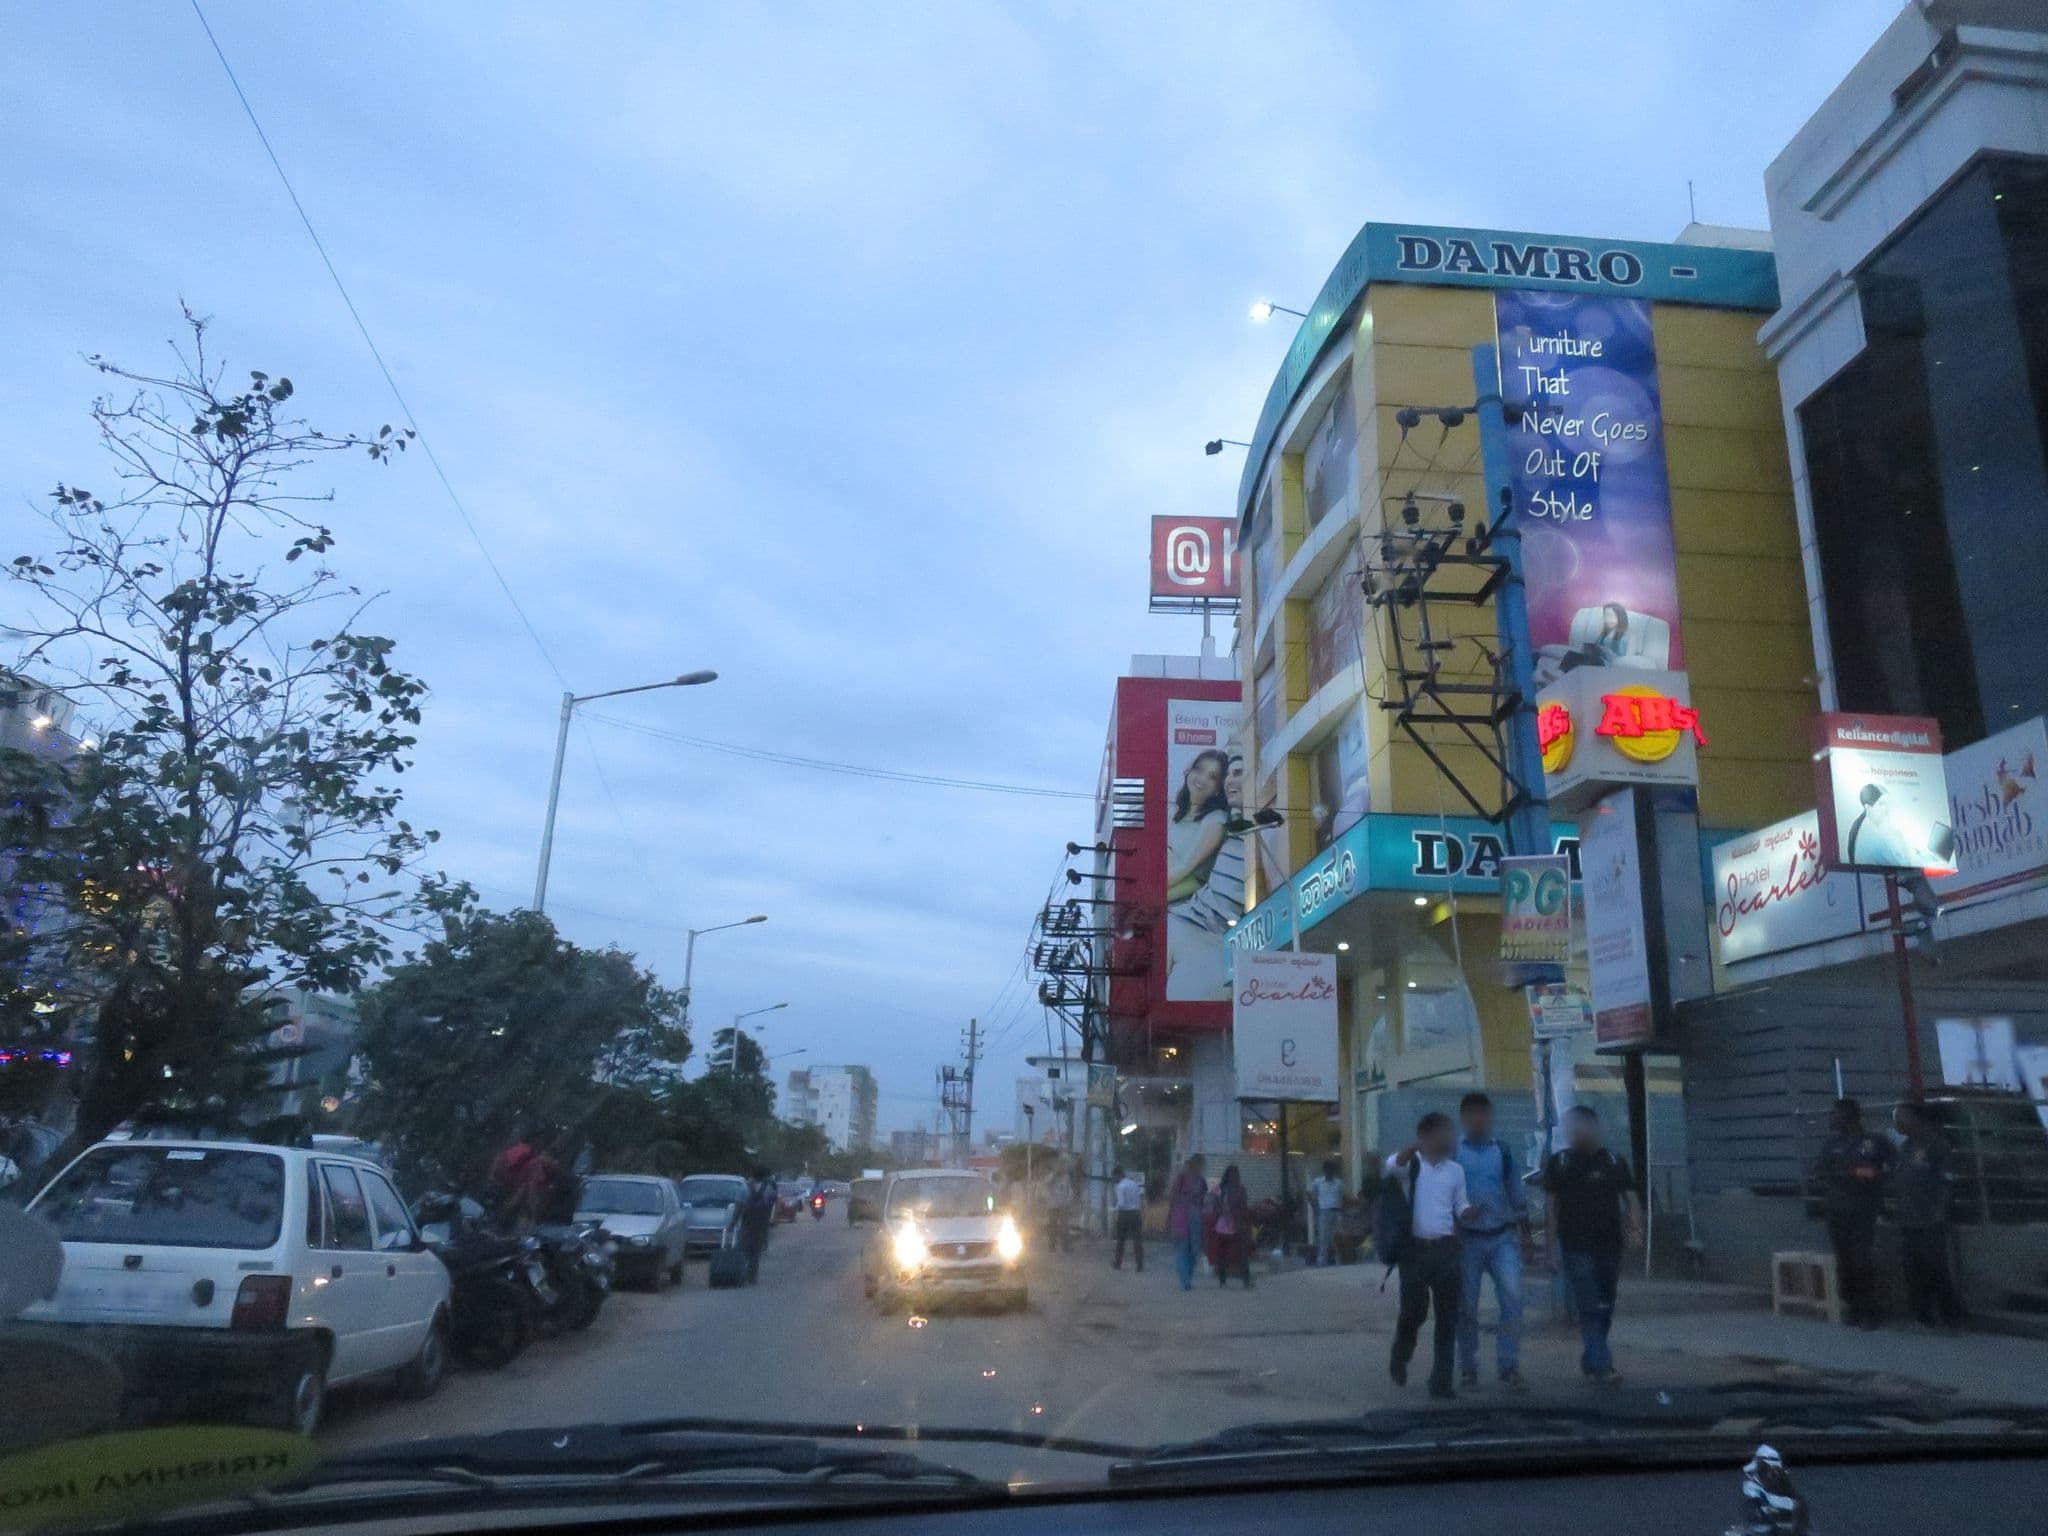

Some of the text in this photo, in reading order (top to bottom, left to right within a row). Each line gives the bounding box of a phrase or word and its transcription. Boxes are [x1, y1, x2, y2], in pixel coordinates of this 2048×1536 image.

[1397, 235, 1644, 286] DAMRO
[1518, 365, 1570, 396] That
[1522, 410, 1648, 446] Never Goes
[1525, 448, 1601, 482] Out Of
[1528, 490, 1593, 524] Style
[1504, 867, 1567, 916] PG
[1740, 865, 1770, 887] Hotel
[1720, 854, 1828, 937] Scarlet
[1239, 978, 1336, 1008] Scarlet
